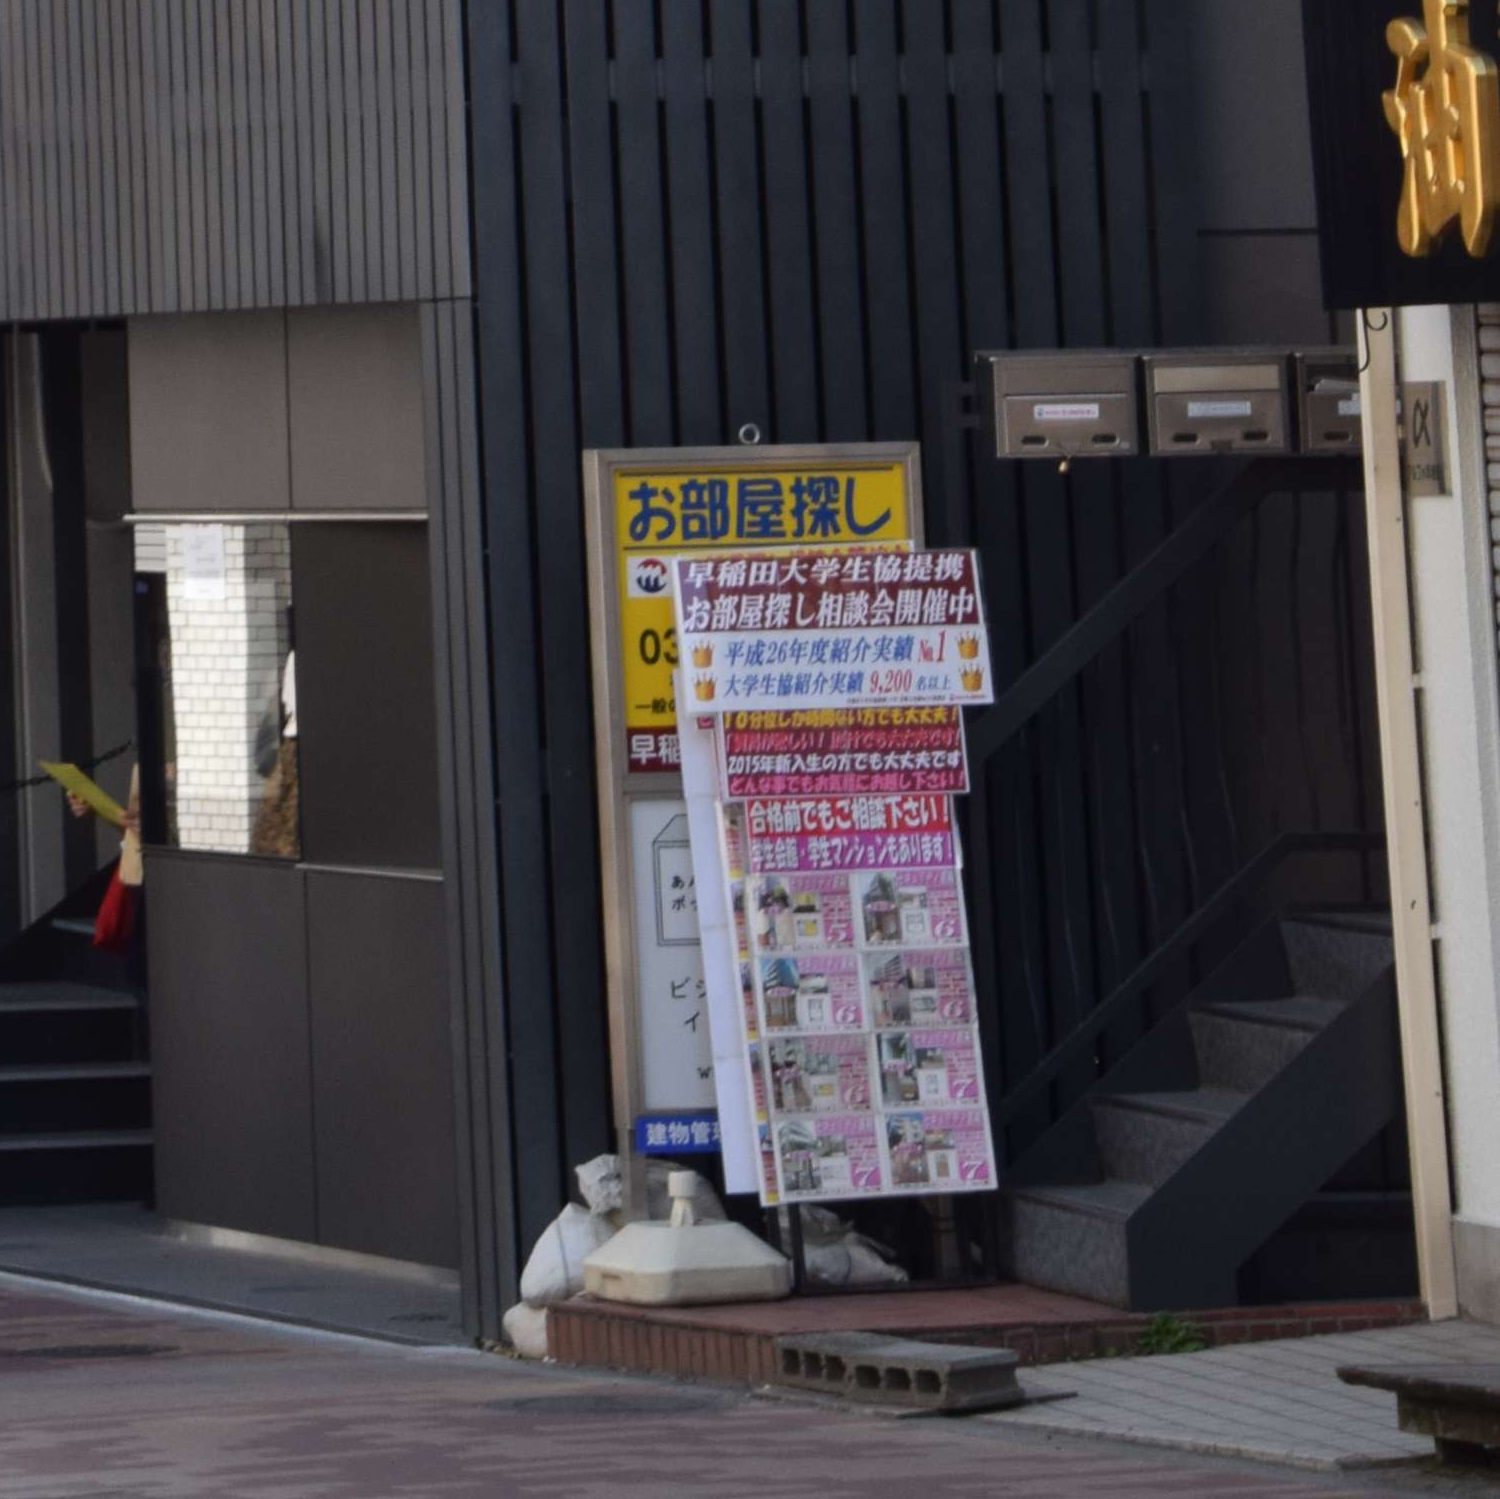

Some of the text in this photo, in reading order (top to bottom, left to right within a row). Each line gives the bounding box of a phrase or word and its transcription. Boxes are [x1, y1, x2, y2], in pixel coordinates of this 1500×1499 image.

[628, 477, 892, 540] お部屋探し
[684, 553, 964, 589] 早稲田大学生協提携
[684, 586, 975, 632] お部屋探し相談会開催中
[723, 671, 864, 698] 大学生協紹介実績
[869, 669, 912, 695] 9,200
